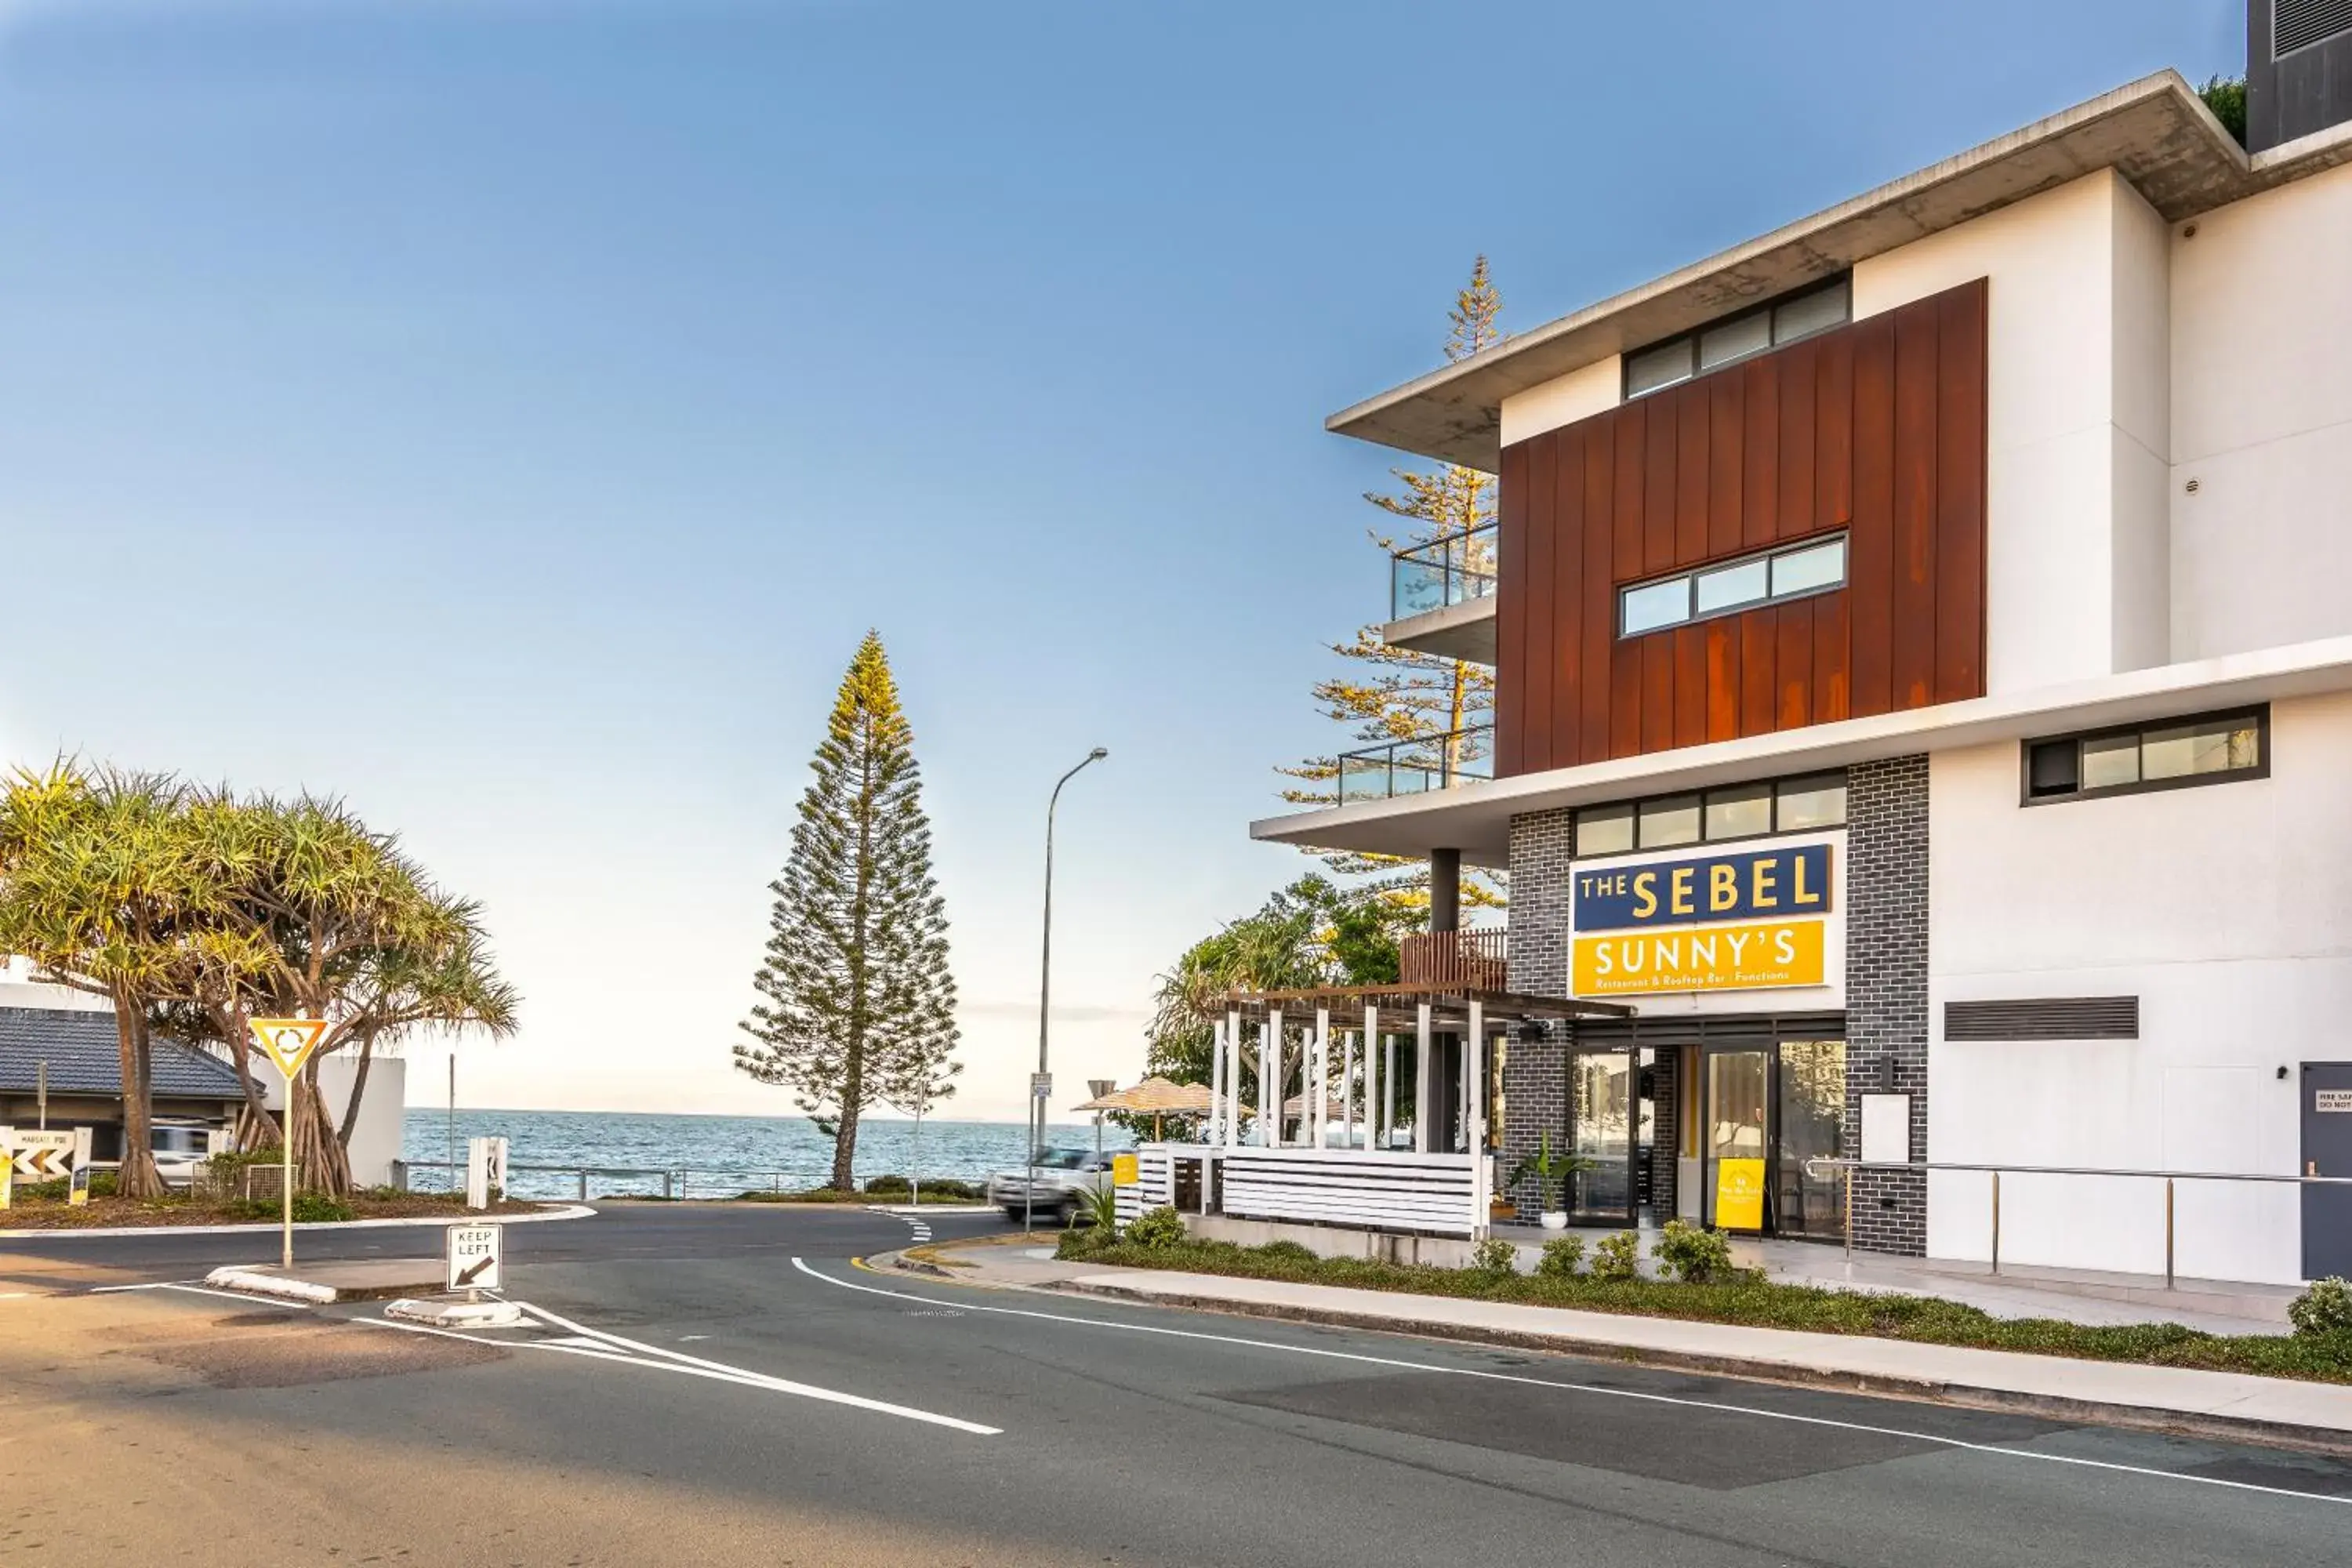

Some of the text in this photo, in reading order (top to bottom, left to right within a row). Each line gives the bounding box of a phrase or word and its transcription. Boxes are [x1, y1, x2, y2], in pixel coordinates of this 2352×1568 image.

[1581, 855, 1820, 918] THE SEBEL
[1595, 929, 1795, 975] SUNNY'S
[1595, 970, 1789, 989] Restaurant & Rooftop Bar Functions
[458, 1231, 492, 1242] KEEP
[458, 1244, 490, 1255] LEFT
